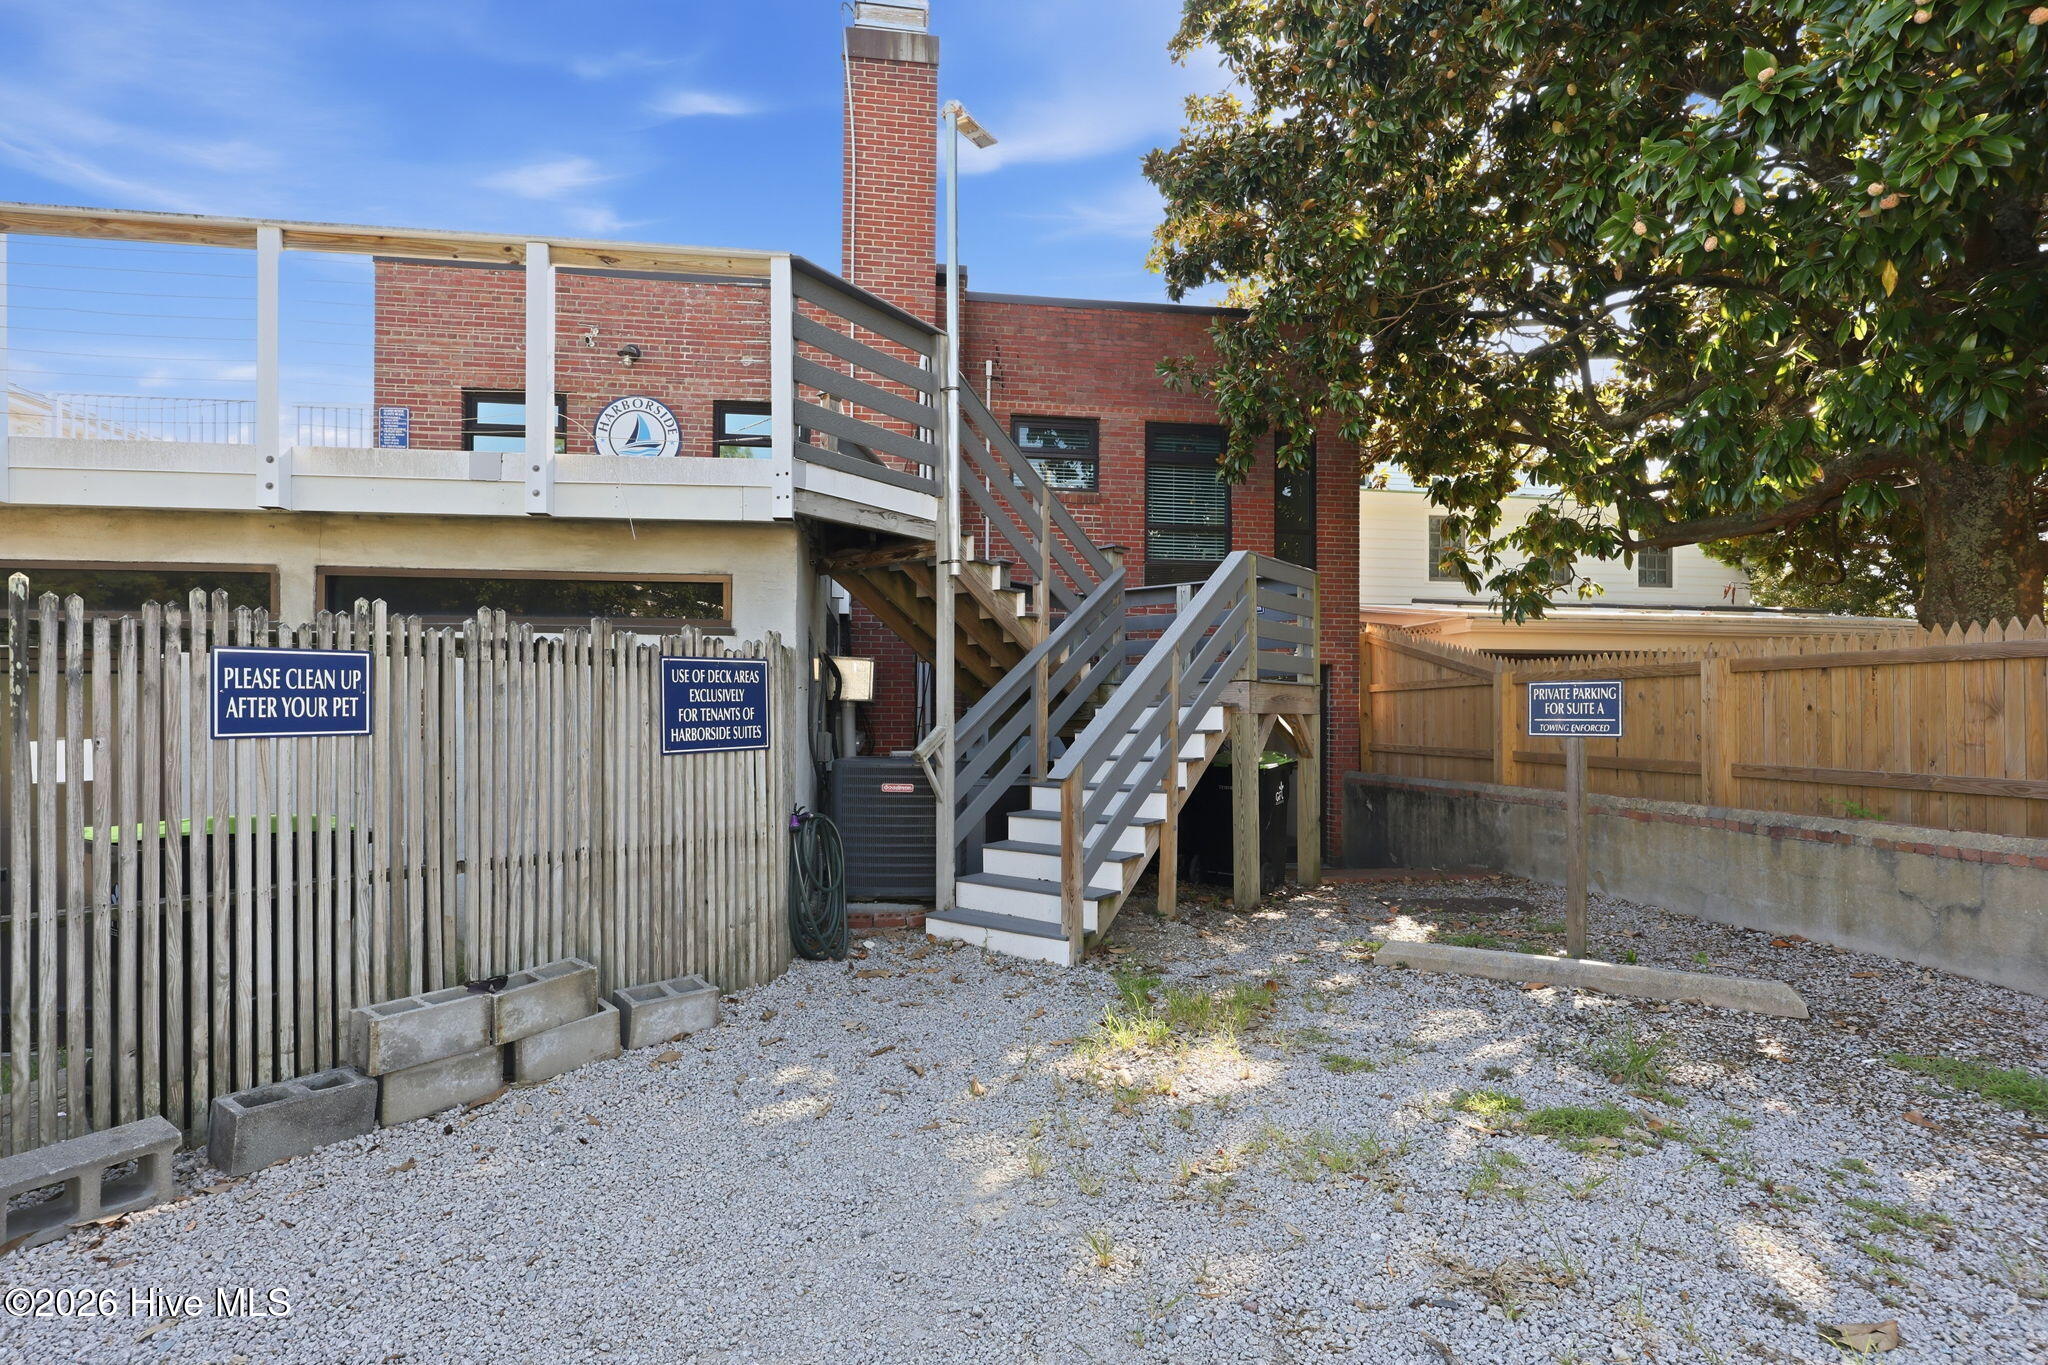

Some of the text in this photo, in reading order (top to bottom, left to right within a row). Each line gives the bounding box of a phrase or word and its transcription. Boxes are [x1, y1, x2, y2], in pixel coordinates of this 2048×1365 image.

[598, 398, 678, 436] HARBORSIDE
[224, 667, 362, 690] PLEASE CLEAN UP
[671, 668, 760, 684] USE OF DECK AREAS
[689, 688, 745, 702] EXCLUSIVELY
[1533, 687, 1617, 700] PRIVATE PARKING
[226, 696, 359, 718] AFTER YOUR PET
[678, 706, 755, 722] FOR TENANTS OF
[1545, 702, 1605, 715] FOR SUITE A
[671, 725, 762, 742] HARBORSIDE SUITES
[1540, 723, 1610, 733] TOWING ENFORCED
